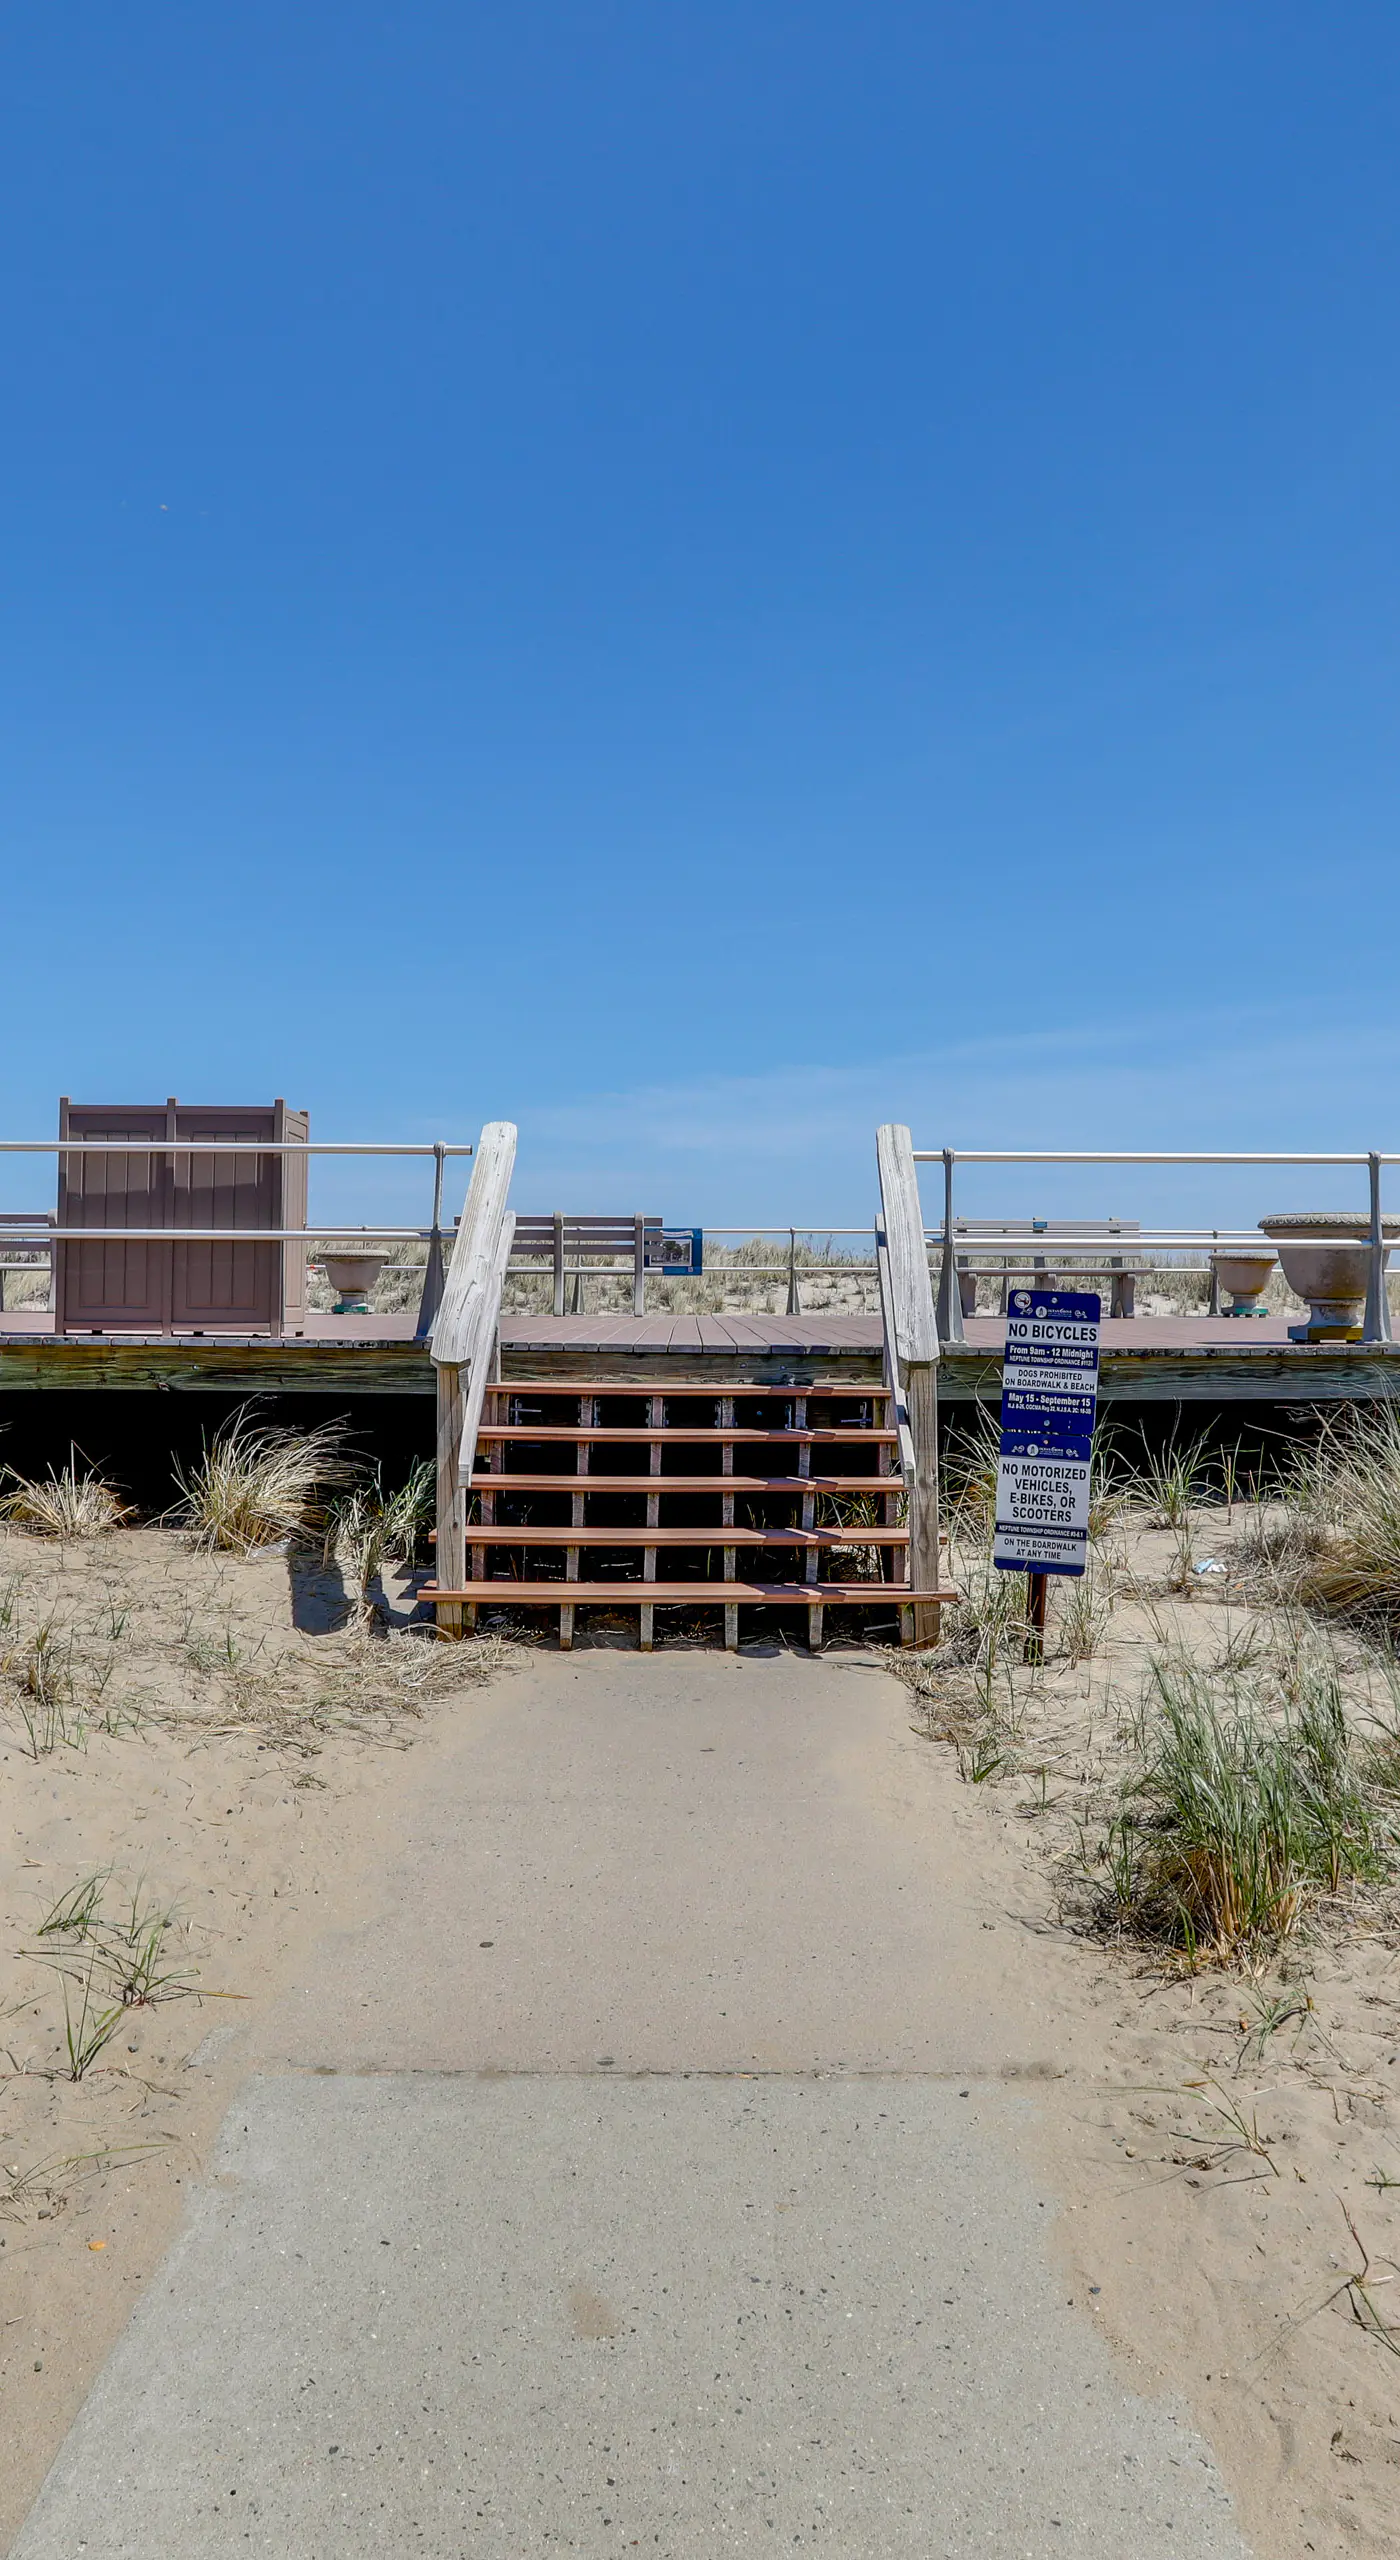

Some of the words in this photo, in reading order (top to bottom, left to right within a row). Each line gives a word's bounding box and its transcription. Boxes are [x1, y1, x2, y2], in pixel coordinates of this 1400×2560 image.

[1008, 1323, 1028, 1337] NO
[1032, 1325, 1097, 1342] BICYCLES
[1009, 1345, 1028, 1354] From
[1029, 1346, 1045, 1355] 9am
[1052, 1348, 1060, 1356] 12
[1061, 1348, 1094, 1359] Midnight
[1009, 1355, 1030, 1363] NEPTUNE
[1031, 1356, 1054, 1364] TOWNSHIP
[1018, 1369, 1038, 1378] DOGS
[1040, 1370, 1083, 1381] PROHIBITED
[1005, 1378, 1015, 1386] ON
[1017, 1378, 1061, 1389] BOARDWALK
[1063, 1382, 1068, 1390] &
[1070, 1382, 1095, 1391] BEACH
[1008, 1392, 1024, 1403] May
[1025, 1394, 1034, 1403] 15
[1040, 1395, 1080, 1405] September
[1081, 1398, 1091, 1406] 15
[1002, 1463, 1018, 1475] NO
[1021, 1464, 1087, 1480] MOTORIZED
[1015, 1478, 1073, 1496] VEHICLES,
[1010, 1492, 1056, 1509] E-BIKES,
[1060, 1496, 1076, 1508] OR
[1012, 1506, 1072, 1522] SCOOTERS
[999, 1524, 1019, 1532] NEPTUNE
[1020, 1526, 1043, 1534] TOWNSHIP
[1044, 1528, 1070, 1537] ORDINANCE
[1004, 1538, 1014, 1546] ON
[1016, 1539, 1030, 1547] THE
[1032, 1540, 1077, 1551] BOARDWALK
[1027, 1550, 1042, 1558] ANY
[1044, 1551, 1061, 1559] TIME
